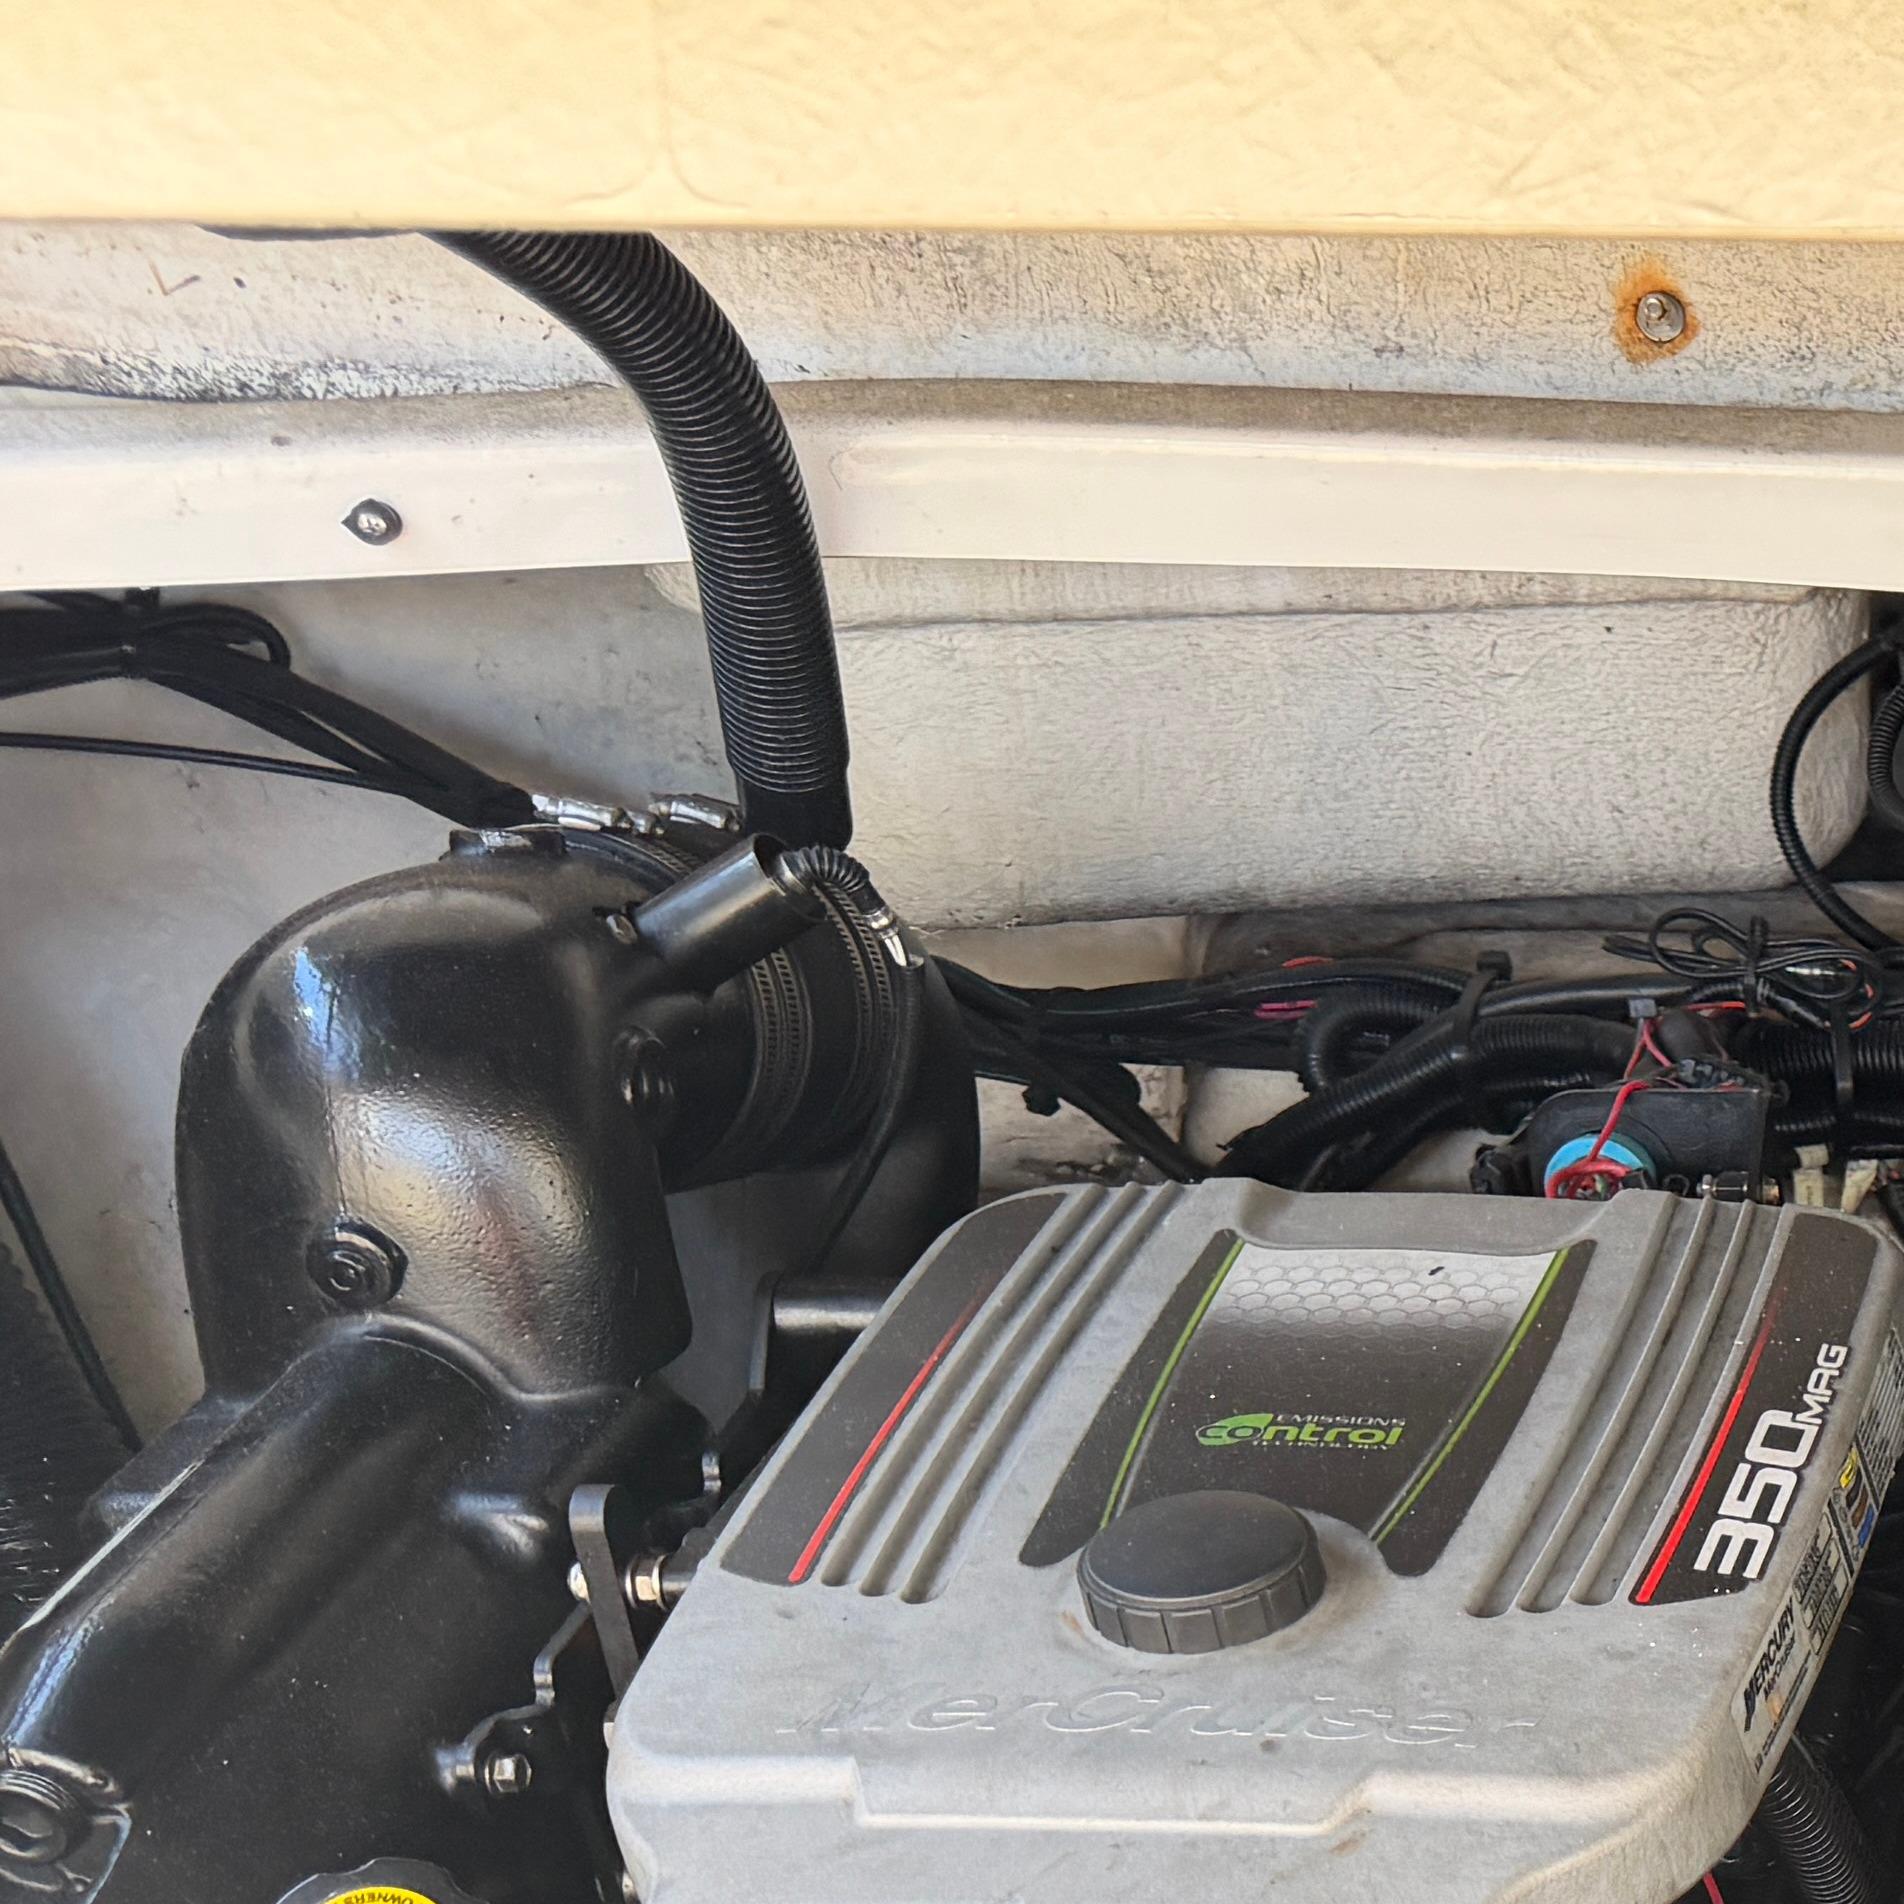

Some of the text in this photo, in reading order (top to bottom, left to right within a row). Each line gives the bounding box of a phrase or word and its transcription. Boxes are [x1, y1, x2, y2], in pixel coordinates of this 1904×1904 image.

[1196, 1422, 1404, 1446] control
[1693, 1409, 1811, 1580] 350
[1796, 1342, 1849, 1426] MAG
[1742, 1597, 1796, 1733] MERCURY
